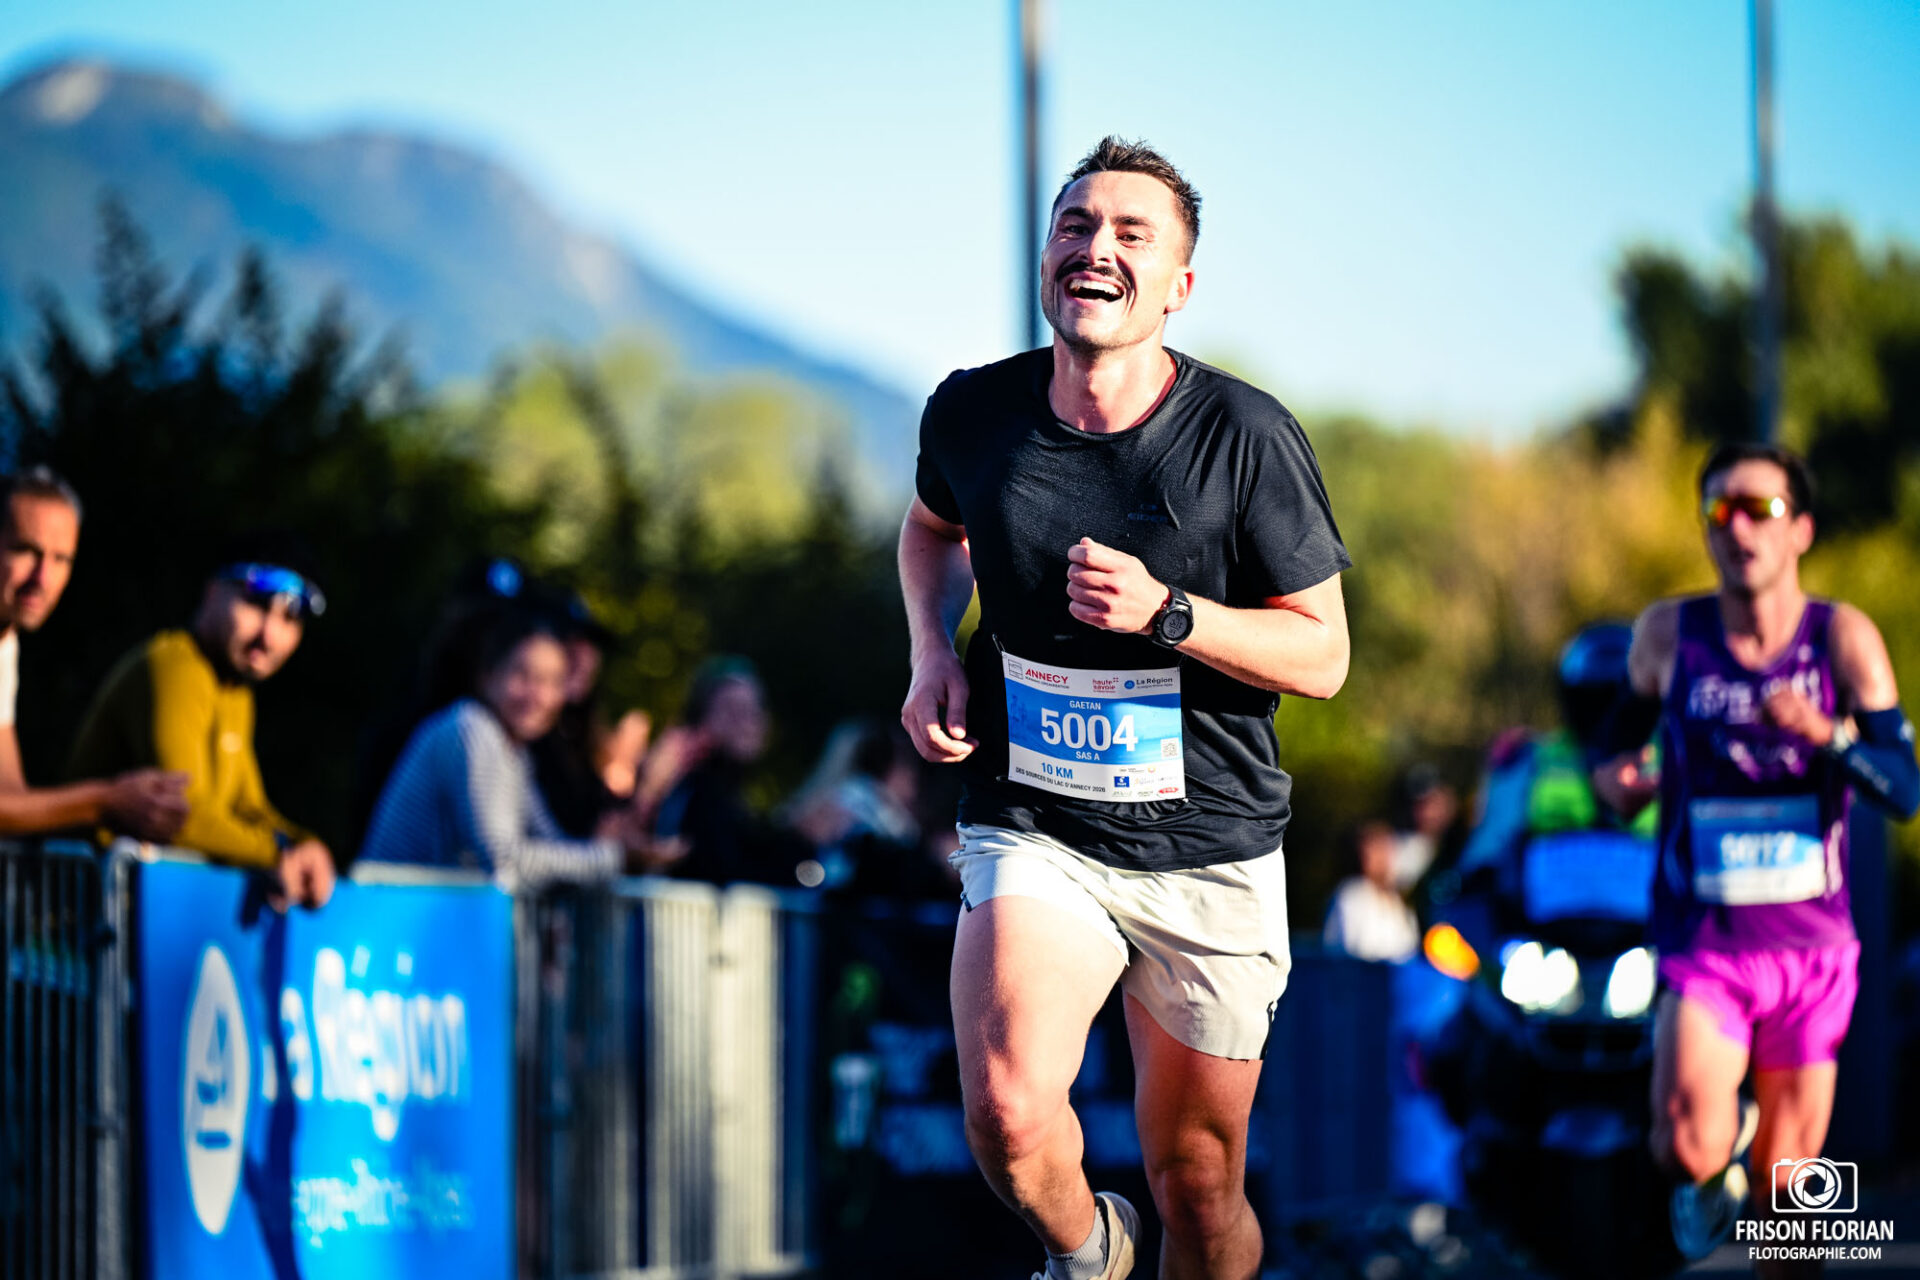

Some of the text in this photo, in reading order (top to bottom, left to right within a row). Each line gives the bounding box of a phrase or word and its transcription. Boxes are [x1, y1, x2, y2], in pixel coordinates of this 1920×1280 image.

[1025, 668, 1069, 684] ANNECY
[1146, 677, 1173, 685] Région
[1069, 700, 1101, 710] GAETAN
[1041, 707, 1139, 752] 5004
[1075, 751, 1100, 761] SAS A
[1016, 766, 1025, 775] DES
[1026, 770, 1046, 782] SOURCES
[1065, 782, 1091, 791] D'ANNECY
[1042, 762, 1073, 780] 10 KM
